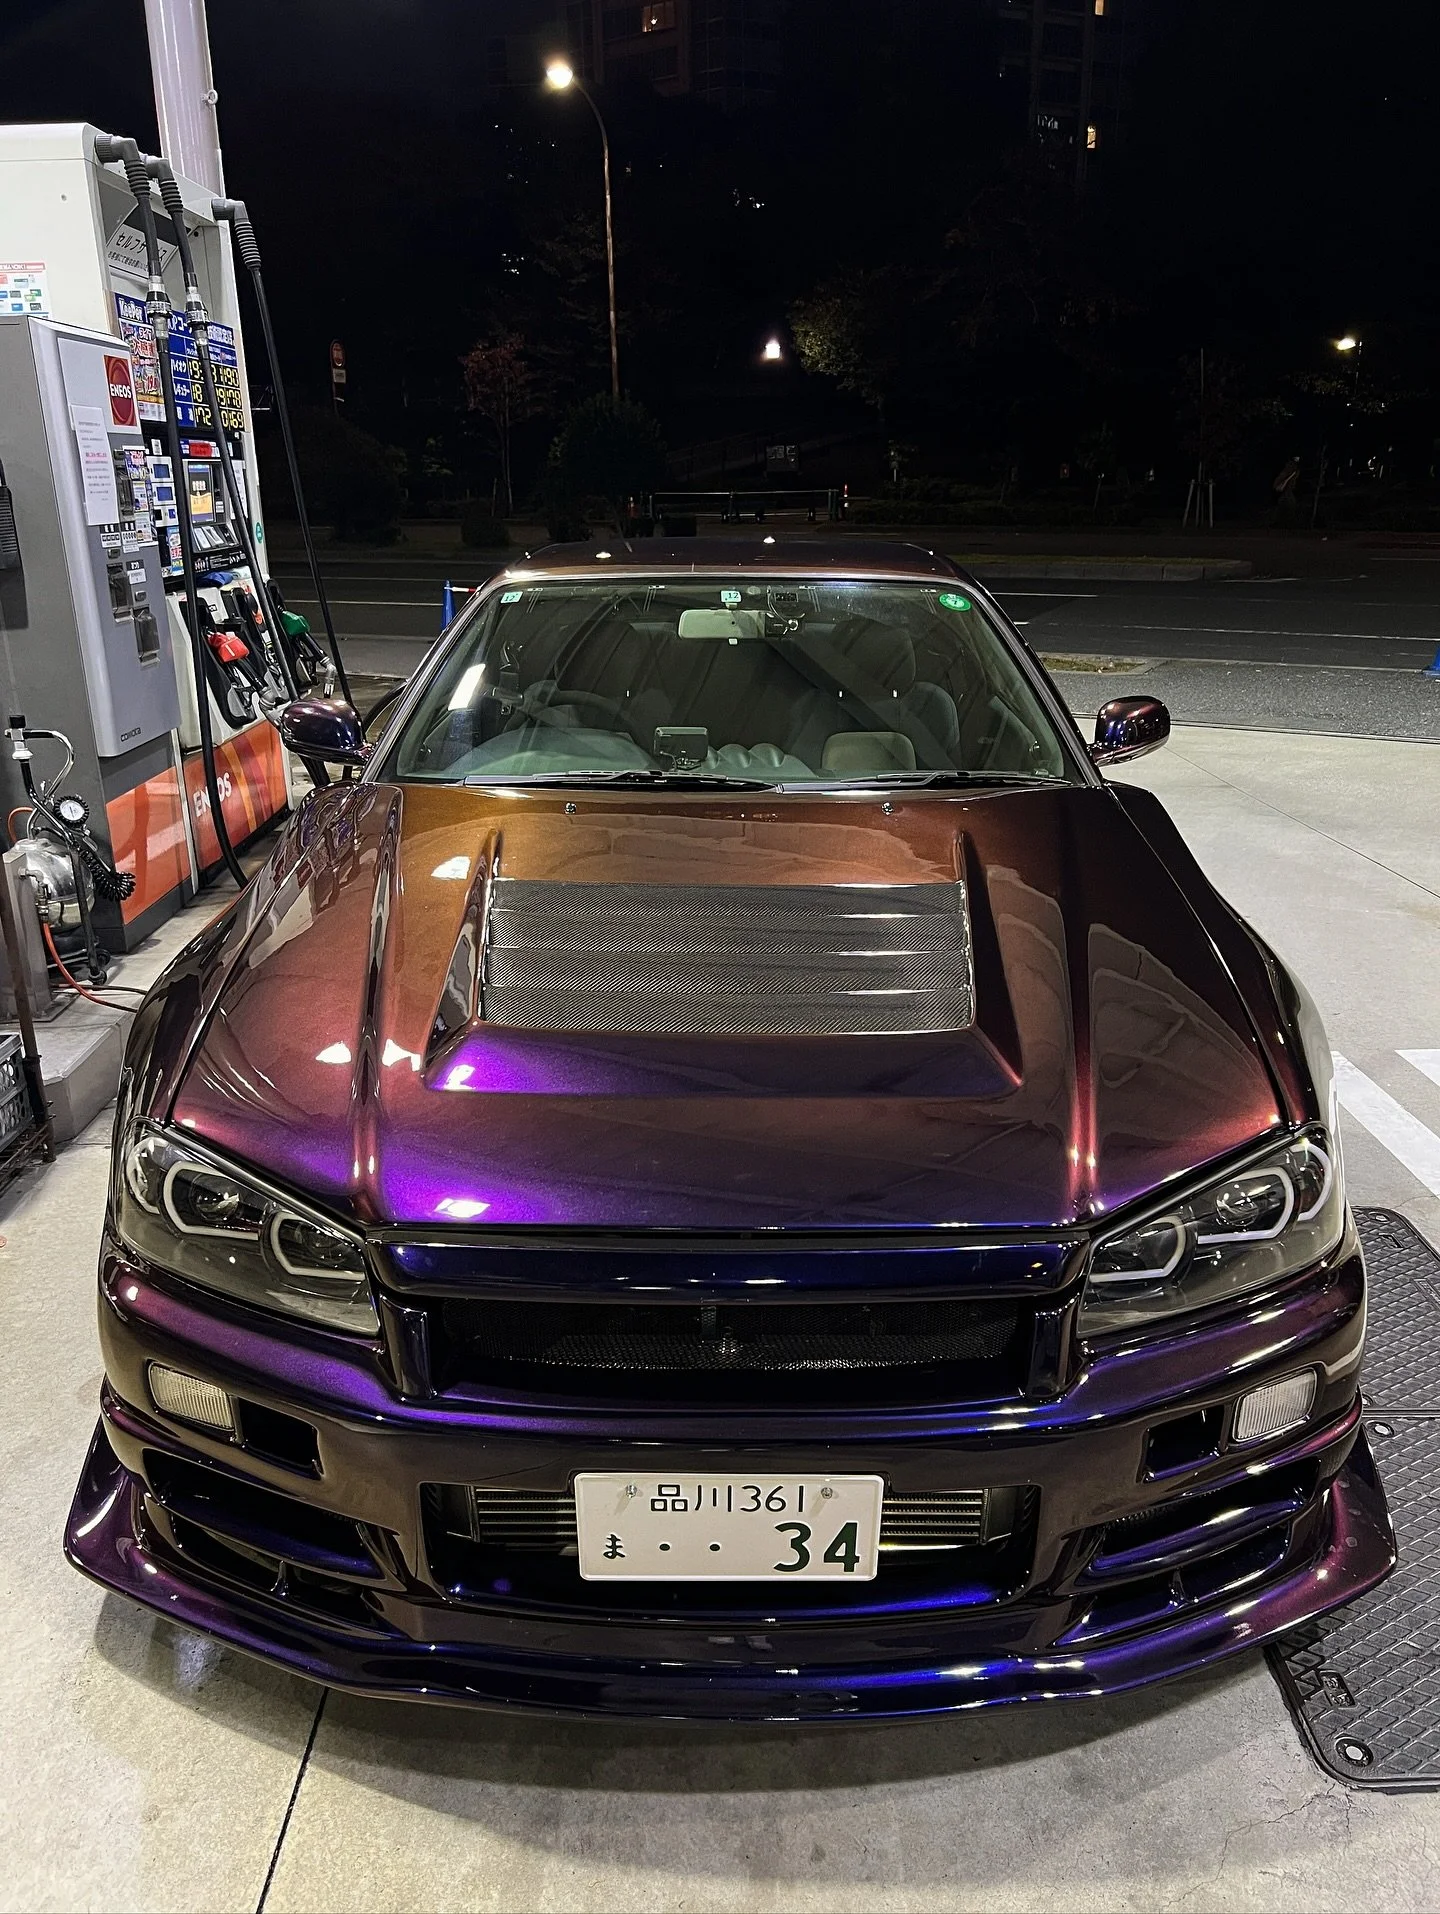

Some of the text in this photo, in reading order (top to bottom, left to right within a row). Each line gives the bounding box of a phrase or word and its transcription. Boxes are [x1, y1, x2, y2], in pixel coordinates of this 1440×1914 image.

[115, 231, 168, 262] セルフサス
[109, 383, 132, 399] ENEOS
[194, 406, 212, 426] 172
[193, 772, 232, 818] ENOS
[602, 1533, 627, 1560] ま
[773, 1520, 861, 1573] 34
